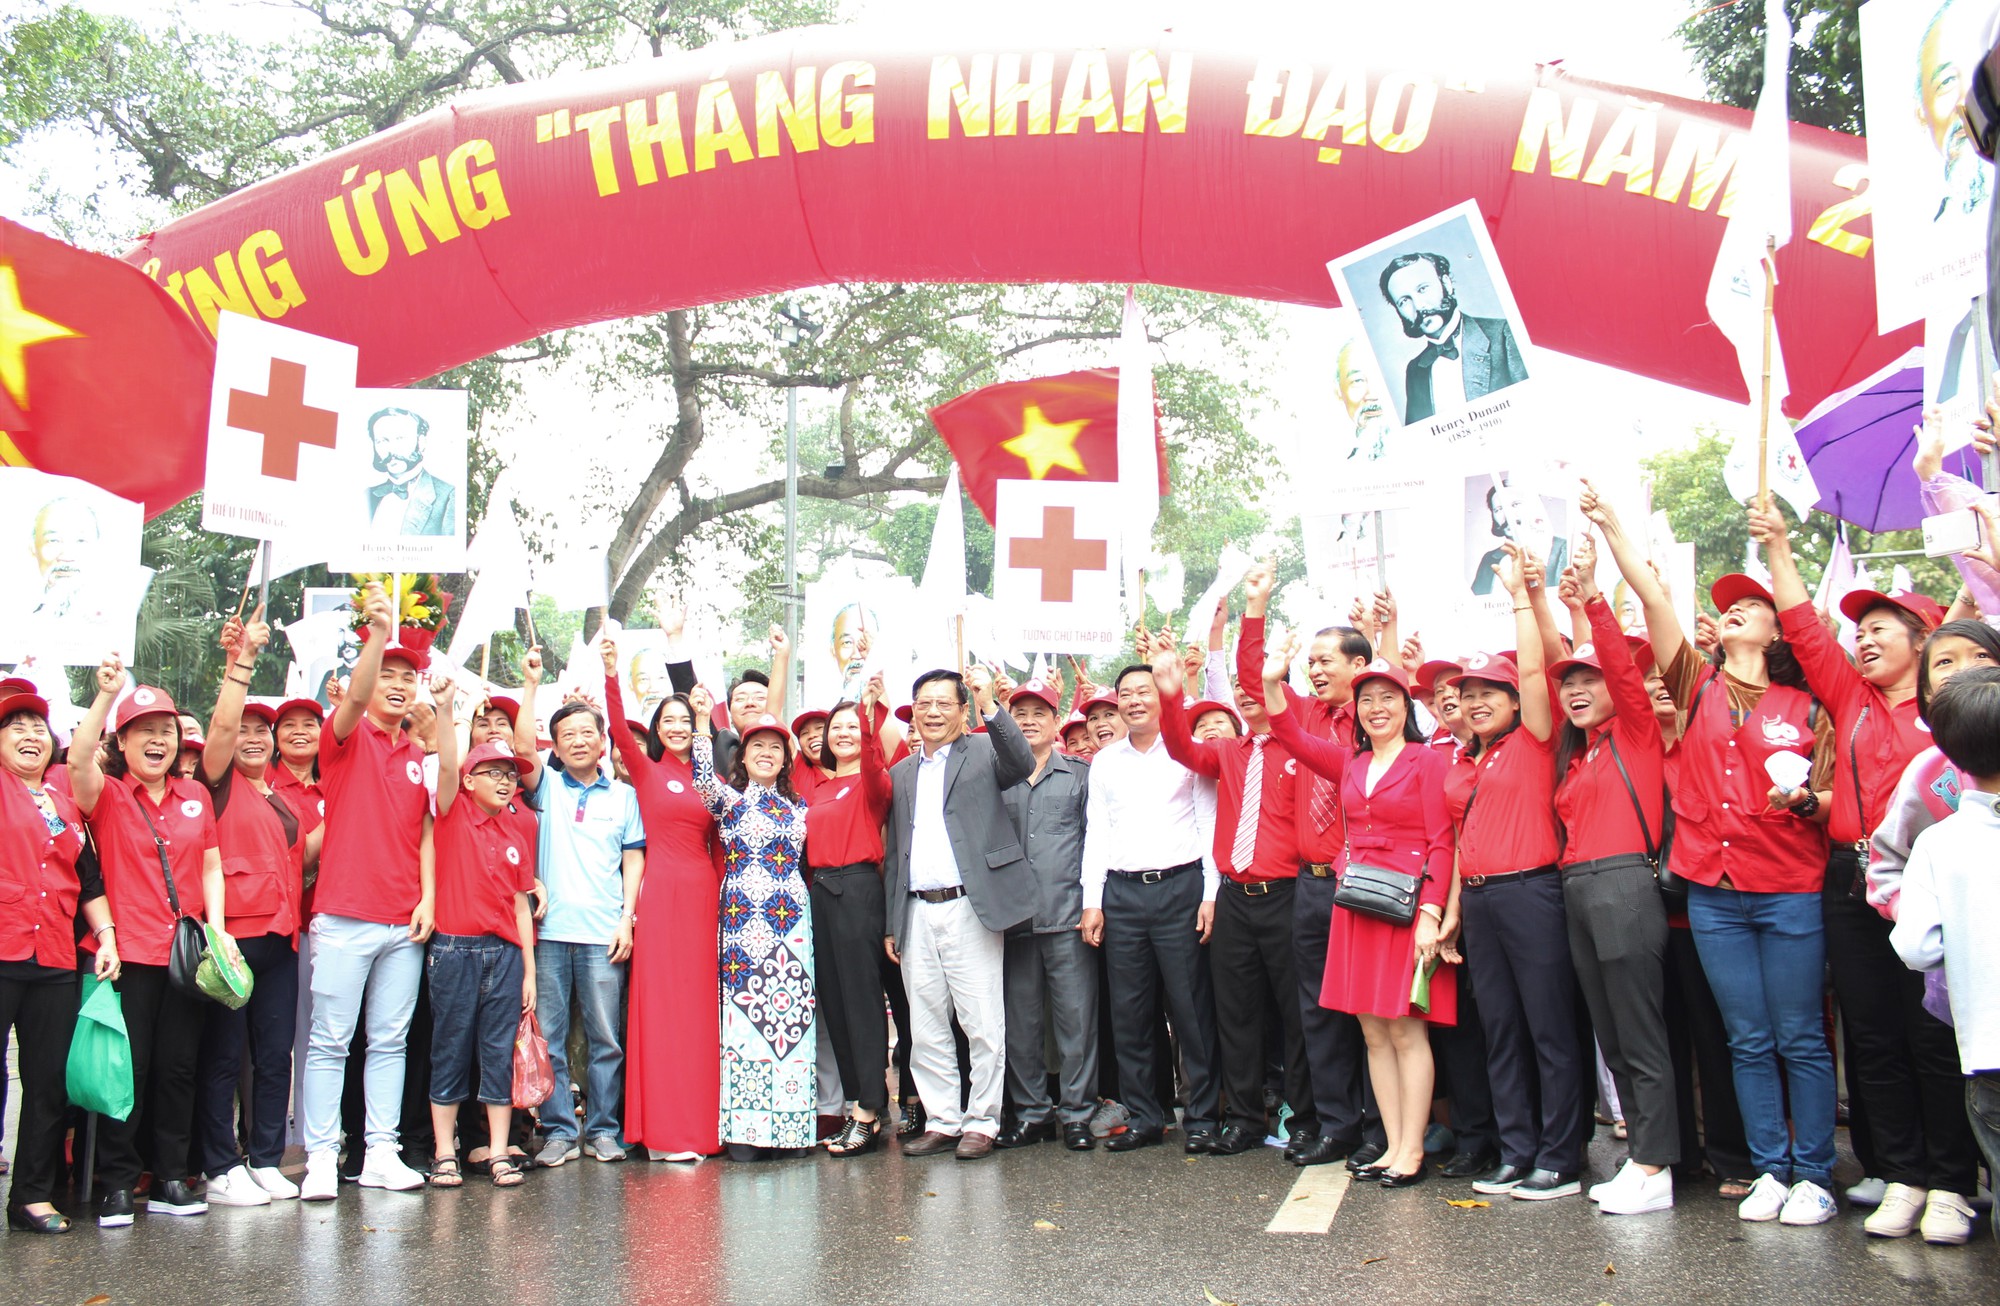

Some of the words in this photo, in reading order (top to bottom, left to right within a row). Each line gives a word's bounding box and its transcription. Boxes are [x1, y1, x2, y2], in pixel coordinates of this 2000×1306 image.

[324, 139, 511, 276] ỨNG
[1430, 418, 1465, 437] Henry
[1467, 399, 1511, 422] Dunant
[1448, 428, 1472, 443] (1828
[1479, 417, 1503, 431] 1910)
